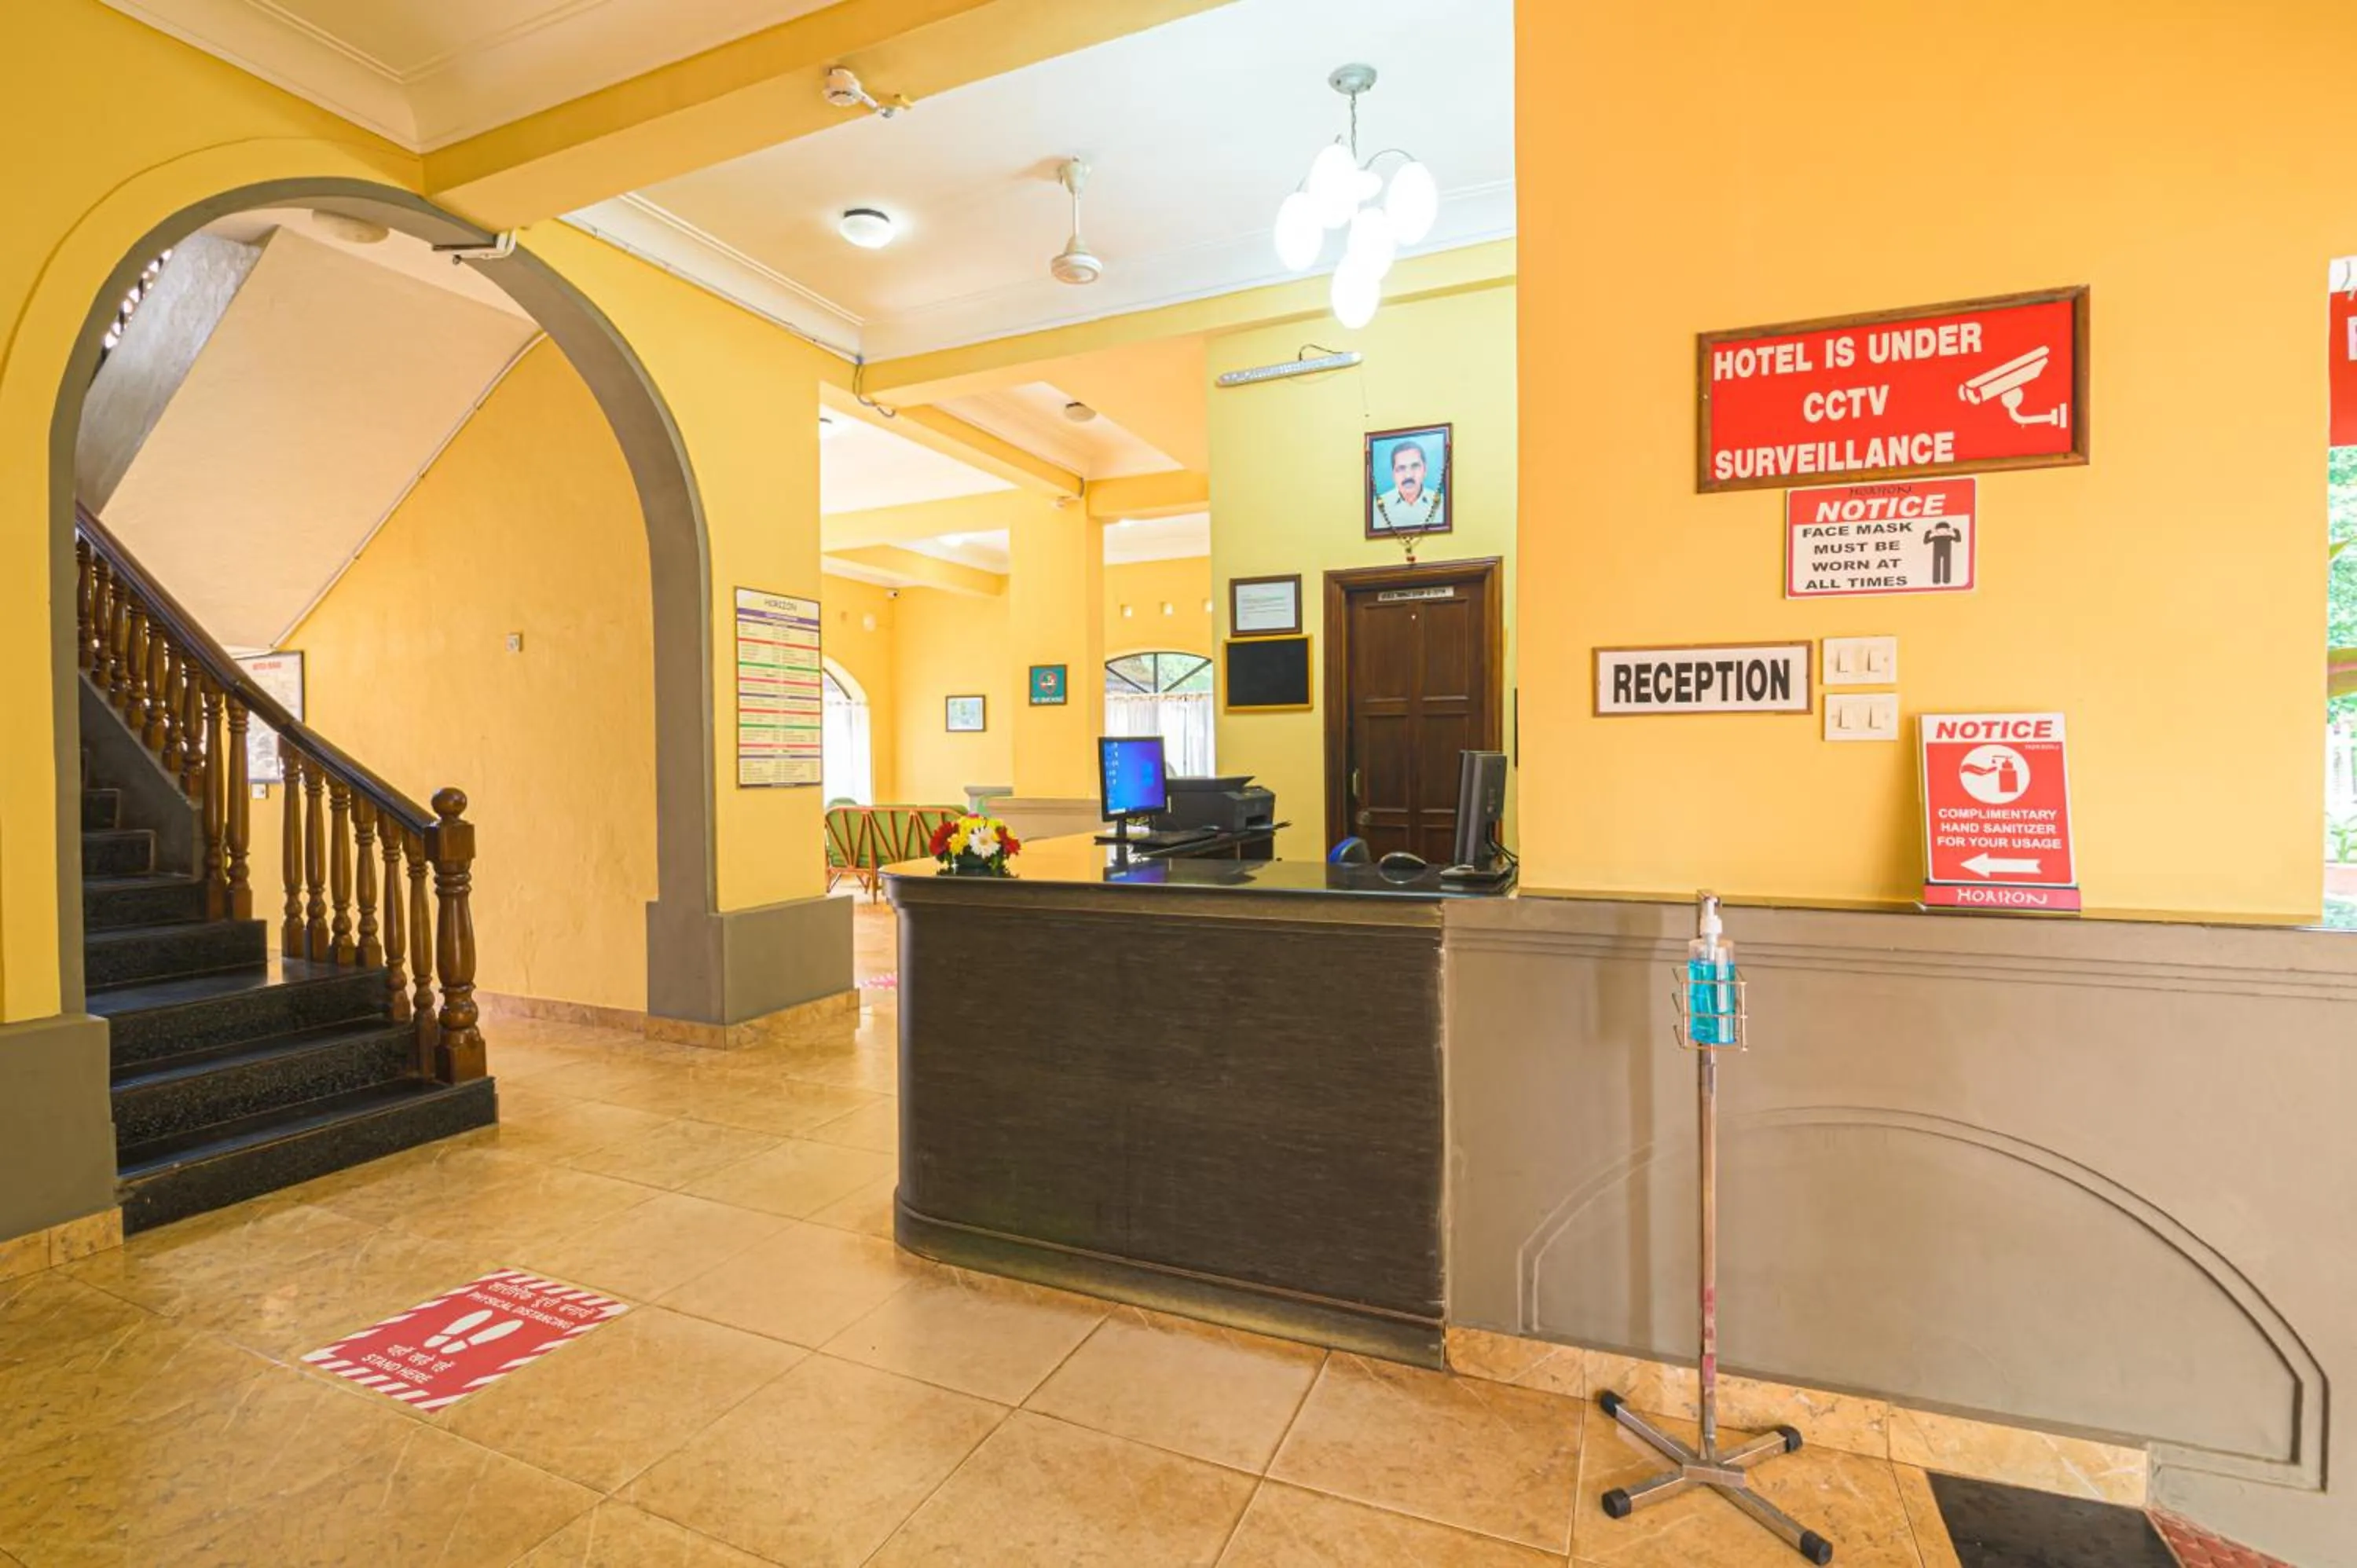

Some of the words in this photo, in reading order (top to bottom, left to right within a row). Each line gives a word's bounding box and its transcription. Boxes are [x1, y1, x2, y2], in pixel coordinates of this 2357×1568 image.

[1713, 343, 1813, 381] HOTEL
[1825, 337, 1855, 370] IS
[1868, 322, 1983, 363] UNDER
[1803, 385, 1890, 423] CCTV
[1715, 431, 1955, 481] SURVEILLANCE
[1816, 494, 1946, 522] NOTICE
[1802, 525, 1849, 538] FACE
[1857, 522, 1912, 535] MASK
[1814, 543, 1868, 555] MUST
[1875, 541, 1900, 551] BE
[1812, 559, 1870, 573] WORN
[1876, 559, 1902, 570] AT
[1805, 578, 1841, 589] ALL
[1847, 575, 1908, 588] TIMES
[1613, 658, 1791, 704] RECEPTION
[1936, 720, 2053, 739] NOTICE
[1938, 808, 2058, 820] COMPLIMENTARY
[1941, 822, 1979, 833] HAND
[1982, 823, 2057, 834] SANITIZER
[1937, 837, 1966, 847] FOR
[1969, 837, 2009, 848] YOUR
[2011, 838, 2062, 849] USAGE
[1957, 888, 2048, 905] HORIZON
[465, 1291, 515, 1310] PHYSICAL
[511, 1306, 575, 1330] DISTANCING
[361, 1354, 402, 1372] STAND
[395, 1366, 434, 1384] HERE
